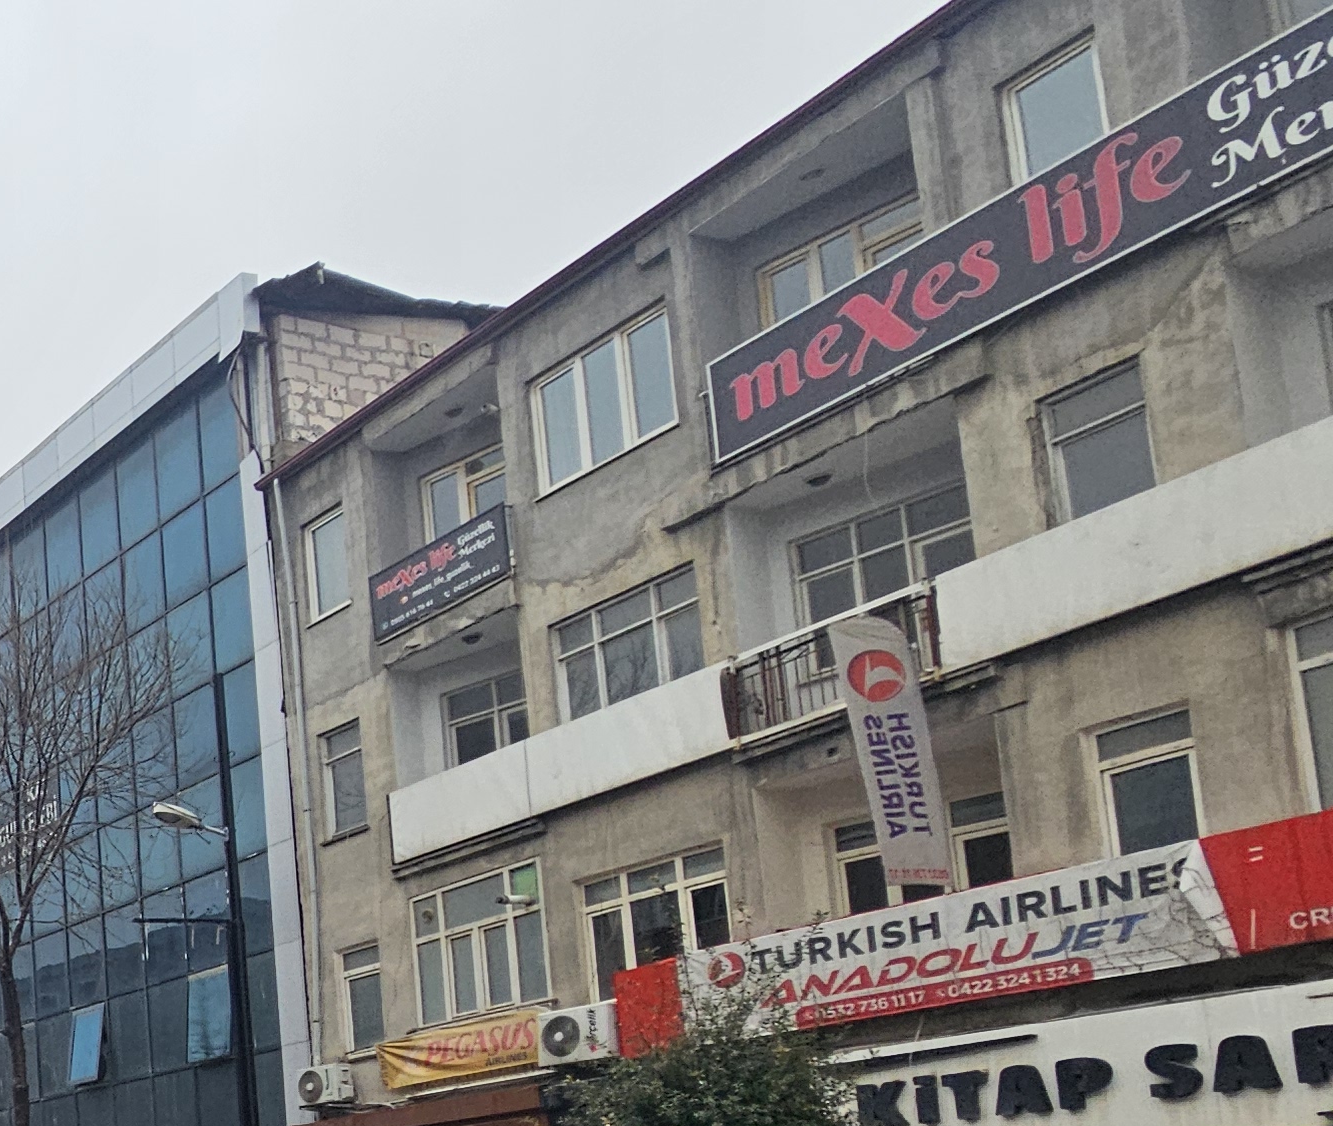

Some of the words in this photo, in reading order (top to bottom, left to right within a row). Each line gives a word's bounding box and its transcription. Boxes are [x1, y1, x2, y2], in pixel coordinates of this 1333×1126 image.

[1207, 36, 1333, 133] Güz
[1017, 132, 1191, 264] life
[751, 911, 941, 975] TURKISH
[1289, 906, 1333, 930] CR
[858, 995, 889, 1014] 736
[947, 977, 993, 998] 0422
[995, 971, 1031, 990] 324
[424, 1017, 536, 1066] PEGASUS
